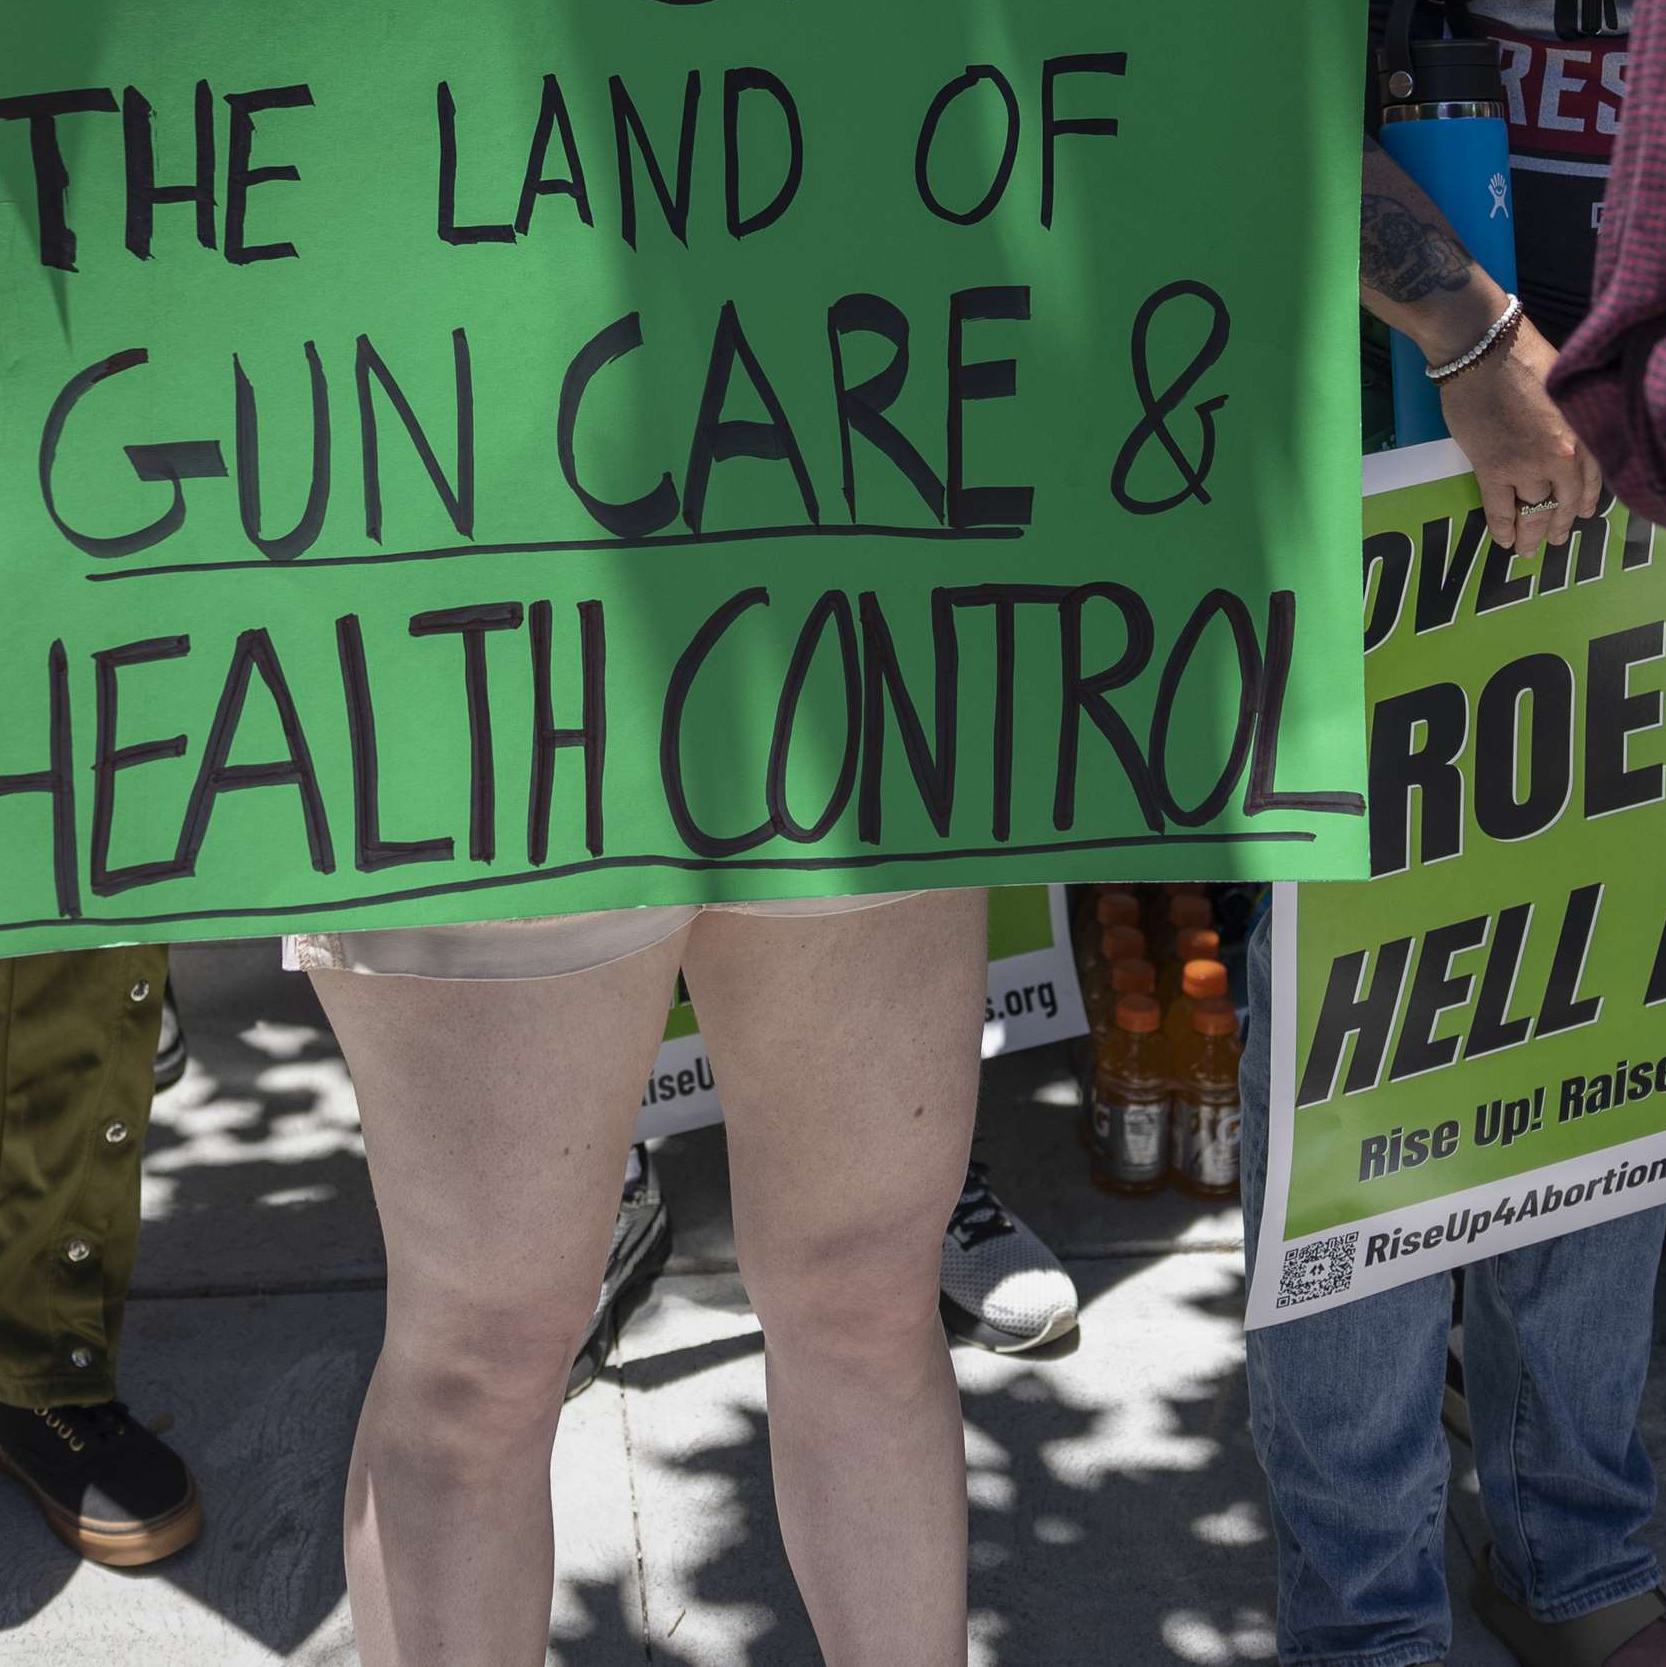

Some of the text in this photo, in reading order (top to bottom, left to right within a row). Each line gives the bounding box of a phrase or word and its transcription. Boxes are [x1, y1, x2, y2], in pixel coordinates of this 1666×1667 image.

[437, 69, 805, 250] LAND
[915, 52, 1129, 231] OF
[38, 280, 1230, 561] GUN CARE &
[659, 581, 1366, 858] CONTROL
[1371, 619, 1666, 879] ROE
[1296, 883, 1605, 1109] HELL
[1359, 1111, 1455, 1184] Rise
[1474, 1087, 1547, 1149] Up!
